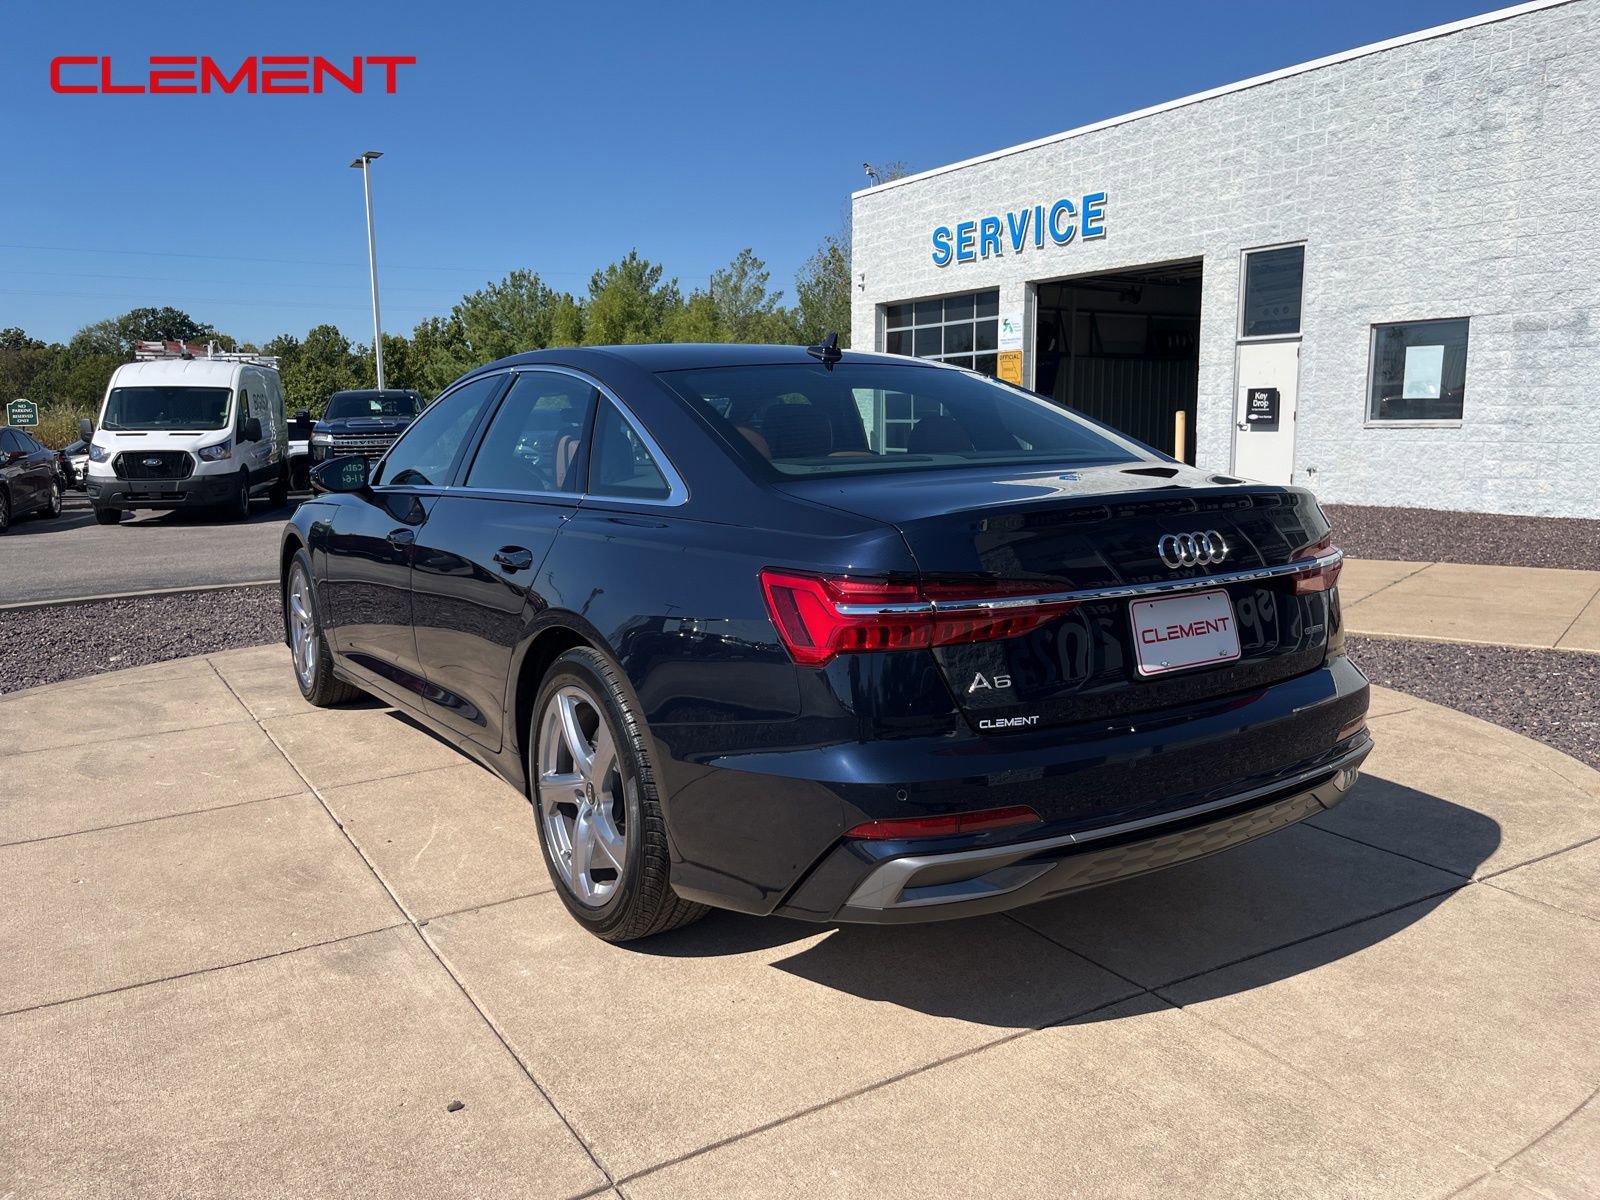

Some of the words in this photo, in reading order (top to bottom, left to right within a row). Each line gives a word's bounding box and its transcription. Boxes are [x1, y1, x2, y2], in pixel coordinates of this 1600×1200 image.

[931, 191, 1107, 267] SERVICE
[999, 353, 1020, 361] OFFICIAL
[1254, 392, 1268, 400] Key
[1253, 400, 1269, 408] Drop
[1141, 617, 1229, 645] CLEMENT
[968, 671, 1012, 693] A6
[979, 715, 1040, 729] CLEMENT
